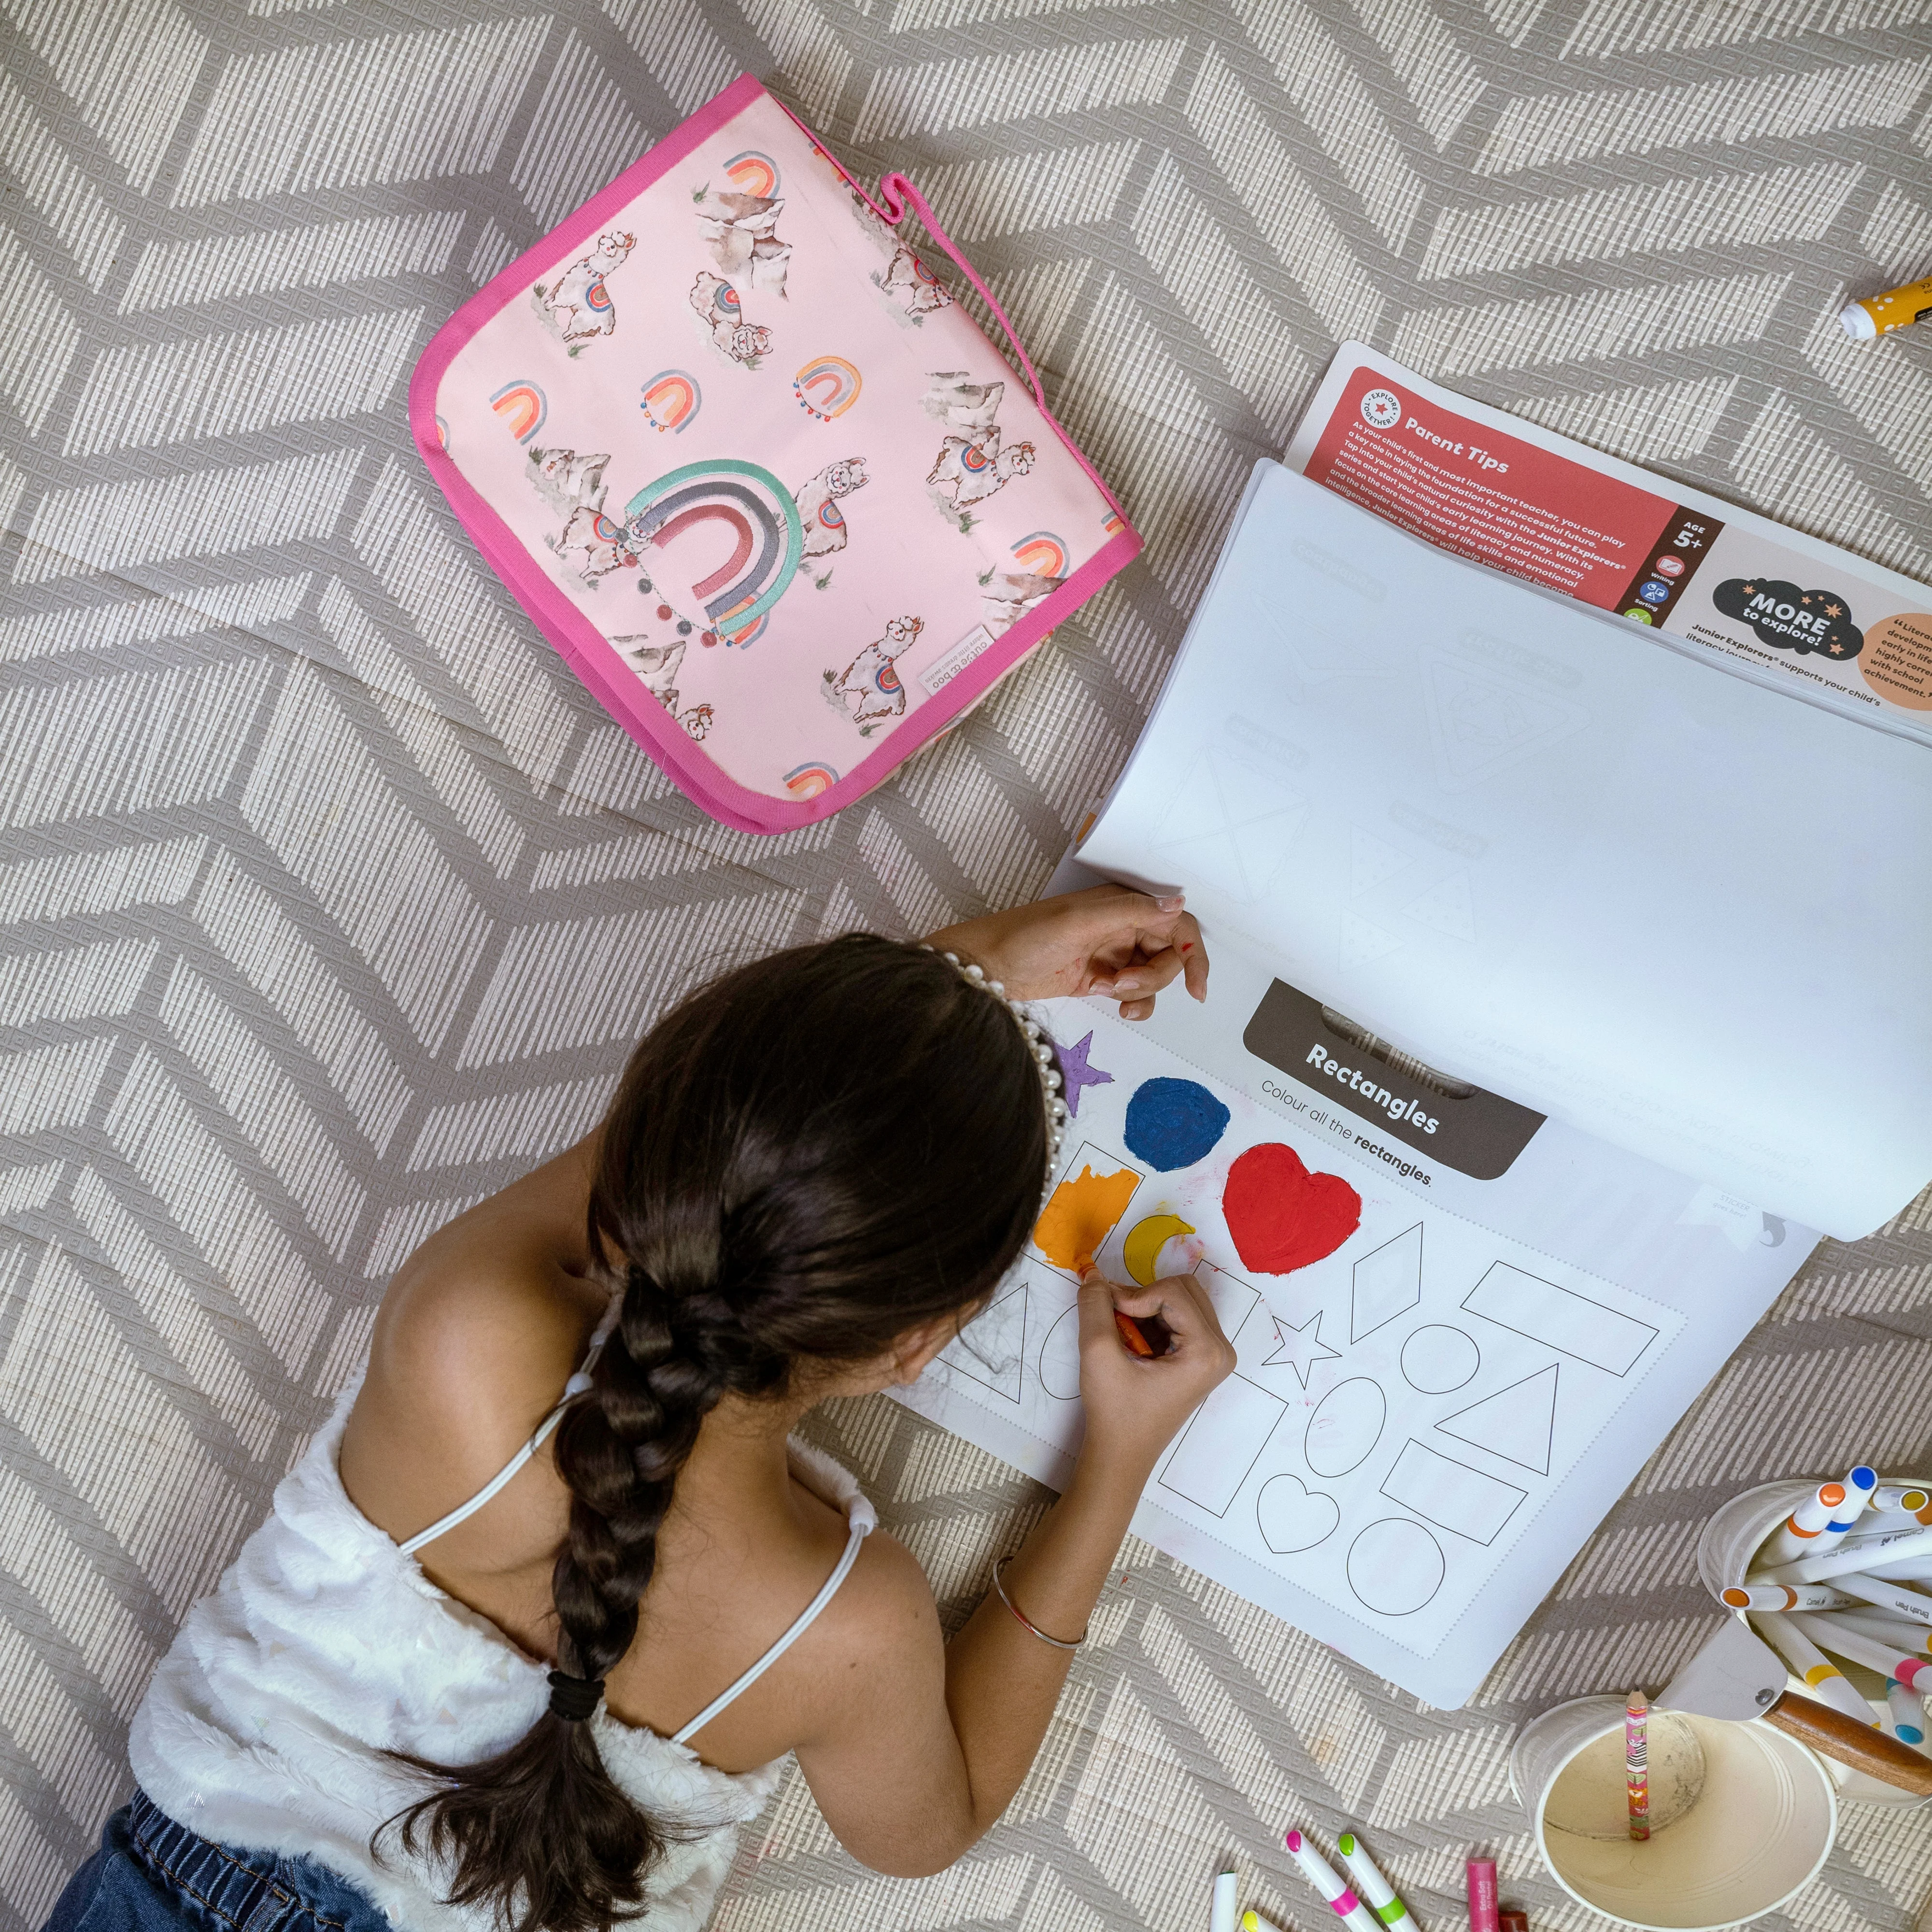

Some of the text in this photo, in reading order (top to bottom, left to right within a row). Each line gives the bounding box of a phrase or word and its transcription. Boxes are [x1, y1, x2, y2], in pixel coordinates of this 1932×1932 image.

[1364, 402, 1395, 426] TOGETHER!
[1371, 392, 1398, 411] EXPLORE
[1405, 417, 1509, 473] Parent Tips
[1345, 439, 1358, 452] Tap
[1359, 447, 1374, 459] into
[1374, 457, 1393, 469] your
[1393, 468, 1418, 484] child's
[1418, 482, 1450, 500] natural
[1450, 498, 1495, 519] curiosity
[1496, 515, 1518, 528] with
[1519, 525, 1536, 535] the
[1537, 532, 1572, 549] Junior
[1352, 421, 1626, 548] As your child's first and most important teacher, you can play
[1354, 433, 1369, 446] key
[1369, 442, 1384, 453] role
[1385, 449, 1392, 458] in
[1393, 455, 1418, 473] laying
[1418, 469, 1431, 480] the
[1431, 476, 1484, 503] foundation
[1485, 499, 1501, 509] for
[1509, 510, 1564, 534] successful
[1564, 530, 1596, 548] future.
[1335, 458, 1356, 474] focus
[1356, 471, 1366, 480] on
[1367, 476, 1380, 487] the
[1381, 485, 1398, 497] core
[1398, 493, 1431, 516] learning
[1431, 512, 1457, 527] areas
[1470, 528, 1509, 549] literacy
[1510, 546, 1531, 557] and
[1531, 554, 1584, 580] numeracy,
[1339, 450, 1593, 570] series and start your child's early learning journey. With its
[1325, 477, 1371, 507] intelligence,
[1372, 504, 1398, 521] Junior
[1439, 540, 1458, 551] will
[1458, 547, 1480, 560] help
[1481, 558, 1506, 570] your
[1506, 568, 1533, 581] child
[1533, 577, 1574, 597] become
[1330, 469, 1346, 480] and
[1346, 477, 1359, 487] the
[1360, 483, 1391, 504] broader
[1391, 501, 1423, 524] learning
[1423, 520, 1447, 535] areas
[1459, 536, 1476, 547] life
[1477, 544, 1503, 557] skills
[1504, 555, 1525, 567] and
[1525, 564, 1578, 588] emotional
[1673, 530, 1703, 549] 5+
[1684, 522, 1705, 534] AGE
[1651, 572, 1675, 586] Writing
[1634, 598, 1659, 612] Sorting
[1748, 593, 1831, 636] MORE
[1743, 608, 1822, 646] to explore!
[1882, 639, 1932, 664] early in life
[1887, 630, 1932, 652] developm
[925, 634, 984, 683] where little dreams awaken
[1691, 625, 1726, 641] Junior
[1780, 660, 1823, 682] supports
[1823, 679, 1847, 693] your
[1848, 689, 1881, 706] child's
[1875, 648, 1905, 665] highly
[933, 672, 953, 688] boo
[1870, 659, 1924, 684] with school
[1306, 1043, 1439, 1134] Rectangles
[1262, 1080, 1432, 1187] Colour all the rectangles.
[1712, 1203, 1747, 1218] goes here!
[1719, 1195, 1750, 1211] STICKER
[1894, 1528, 1925, 1541] Camel
[1839, 1545, 1862, 1555] Brush
[1895, 1601, 1929, 1619] Brush Pen
